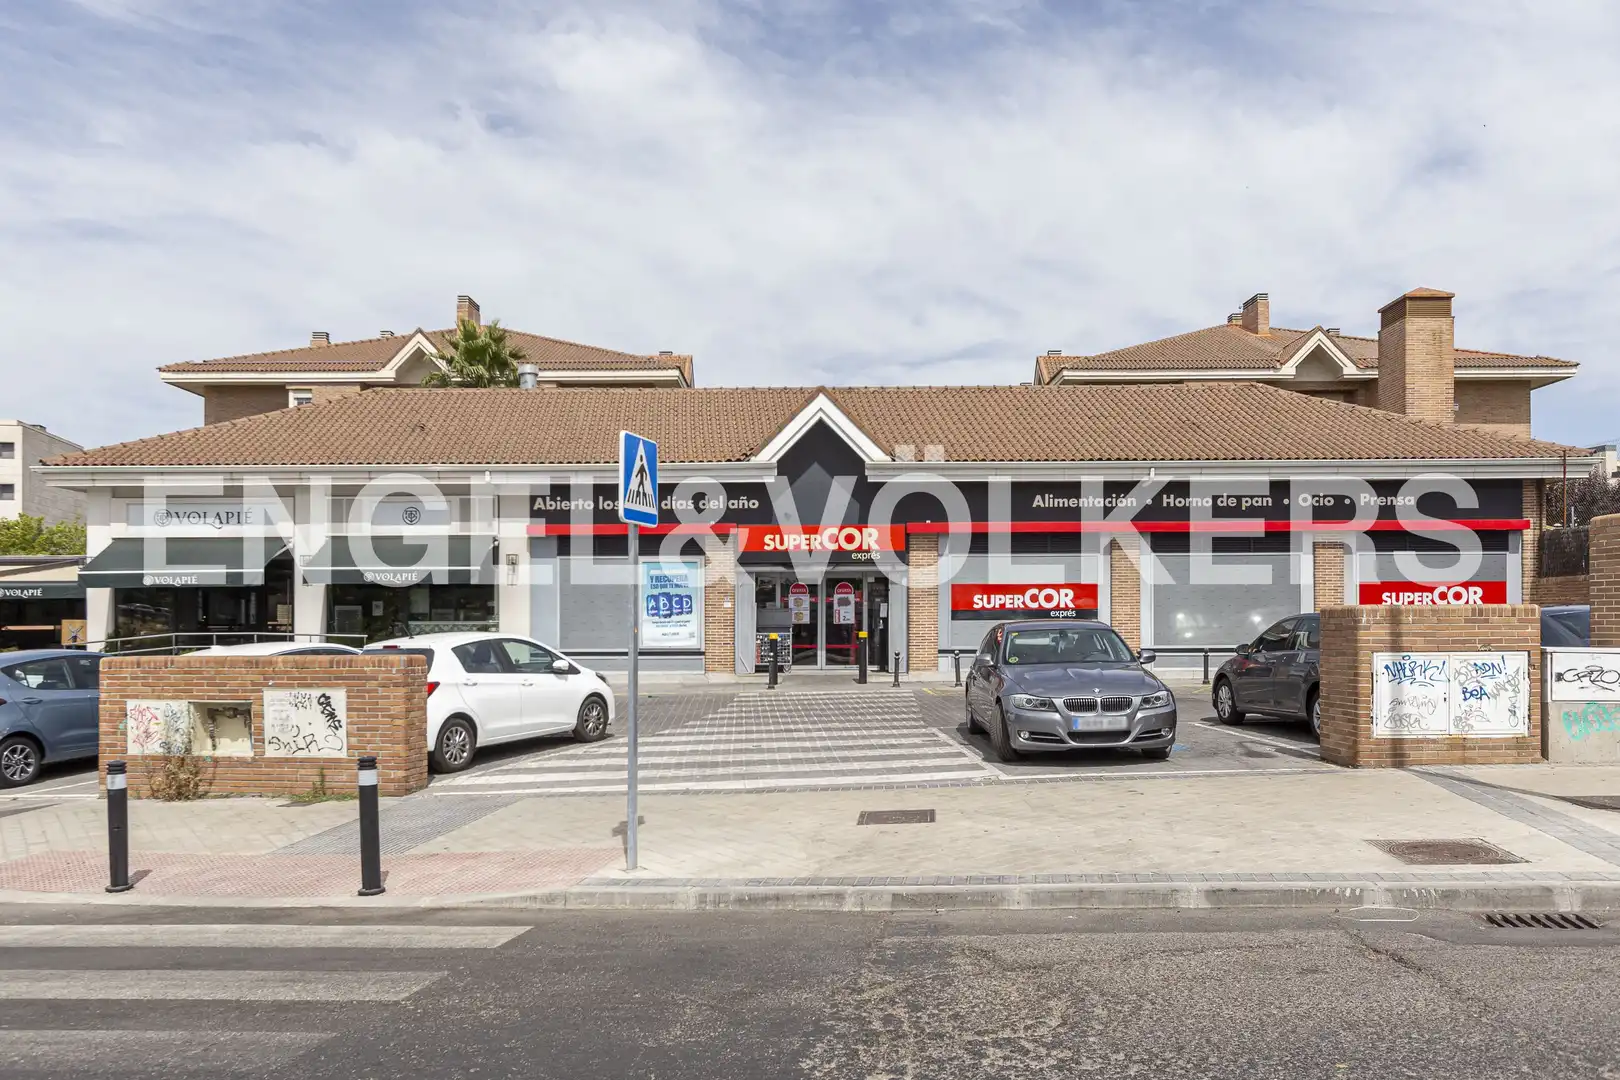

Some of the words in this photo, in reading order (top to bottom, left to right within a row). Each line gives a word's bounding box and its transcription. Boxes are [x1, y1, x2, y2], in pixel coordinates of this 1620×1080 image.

[533, 496, 594, 510] Abierto
[660, 496, 694, 510] días
[699, 496, 724, 510] del
[728, 496, 759, 509] año
[1032, 493, 1137, 508] Alimentación
[1162, 494, 1213, 507] Horno
[1217, 493, 1237, 507] de
[1242, 495, 1273, 511] pan
[1298, 493, 1335, 507] Ocio
[1360, 493, 1415, 507] Prensa
[174, 508, 253, 529] VOLAPIÉ
[763, 527, 881, 550] SUPERCOR
[851, 551, 881, 562] exprés
[154, 574, 198, 586] VOLAPIÉ
[375, 571, 418, 584] VOLAPIÉ
[4, 587, 43, 598] VOLAPIÉ
[973, 588, 1076, 609] SUPERCOR
[1381, 586, 1483, 605] SUPERCOR
[660, 597, 670, 610] B
[672, 597, 681, 608] C
[683, 598, 692, 608] D
[1050, 609, 1076, 618] exprés
